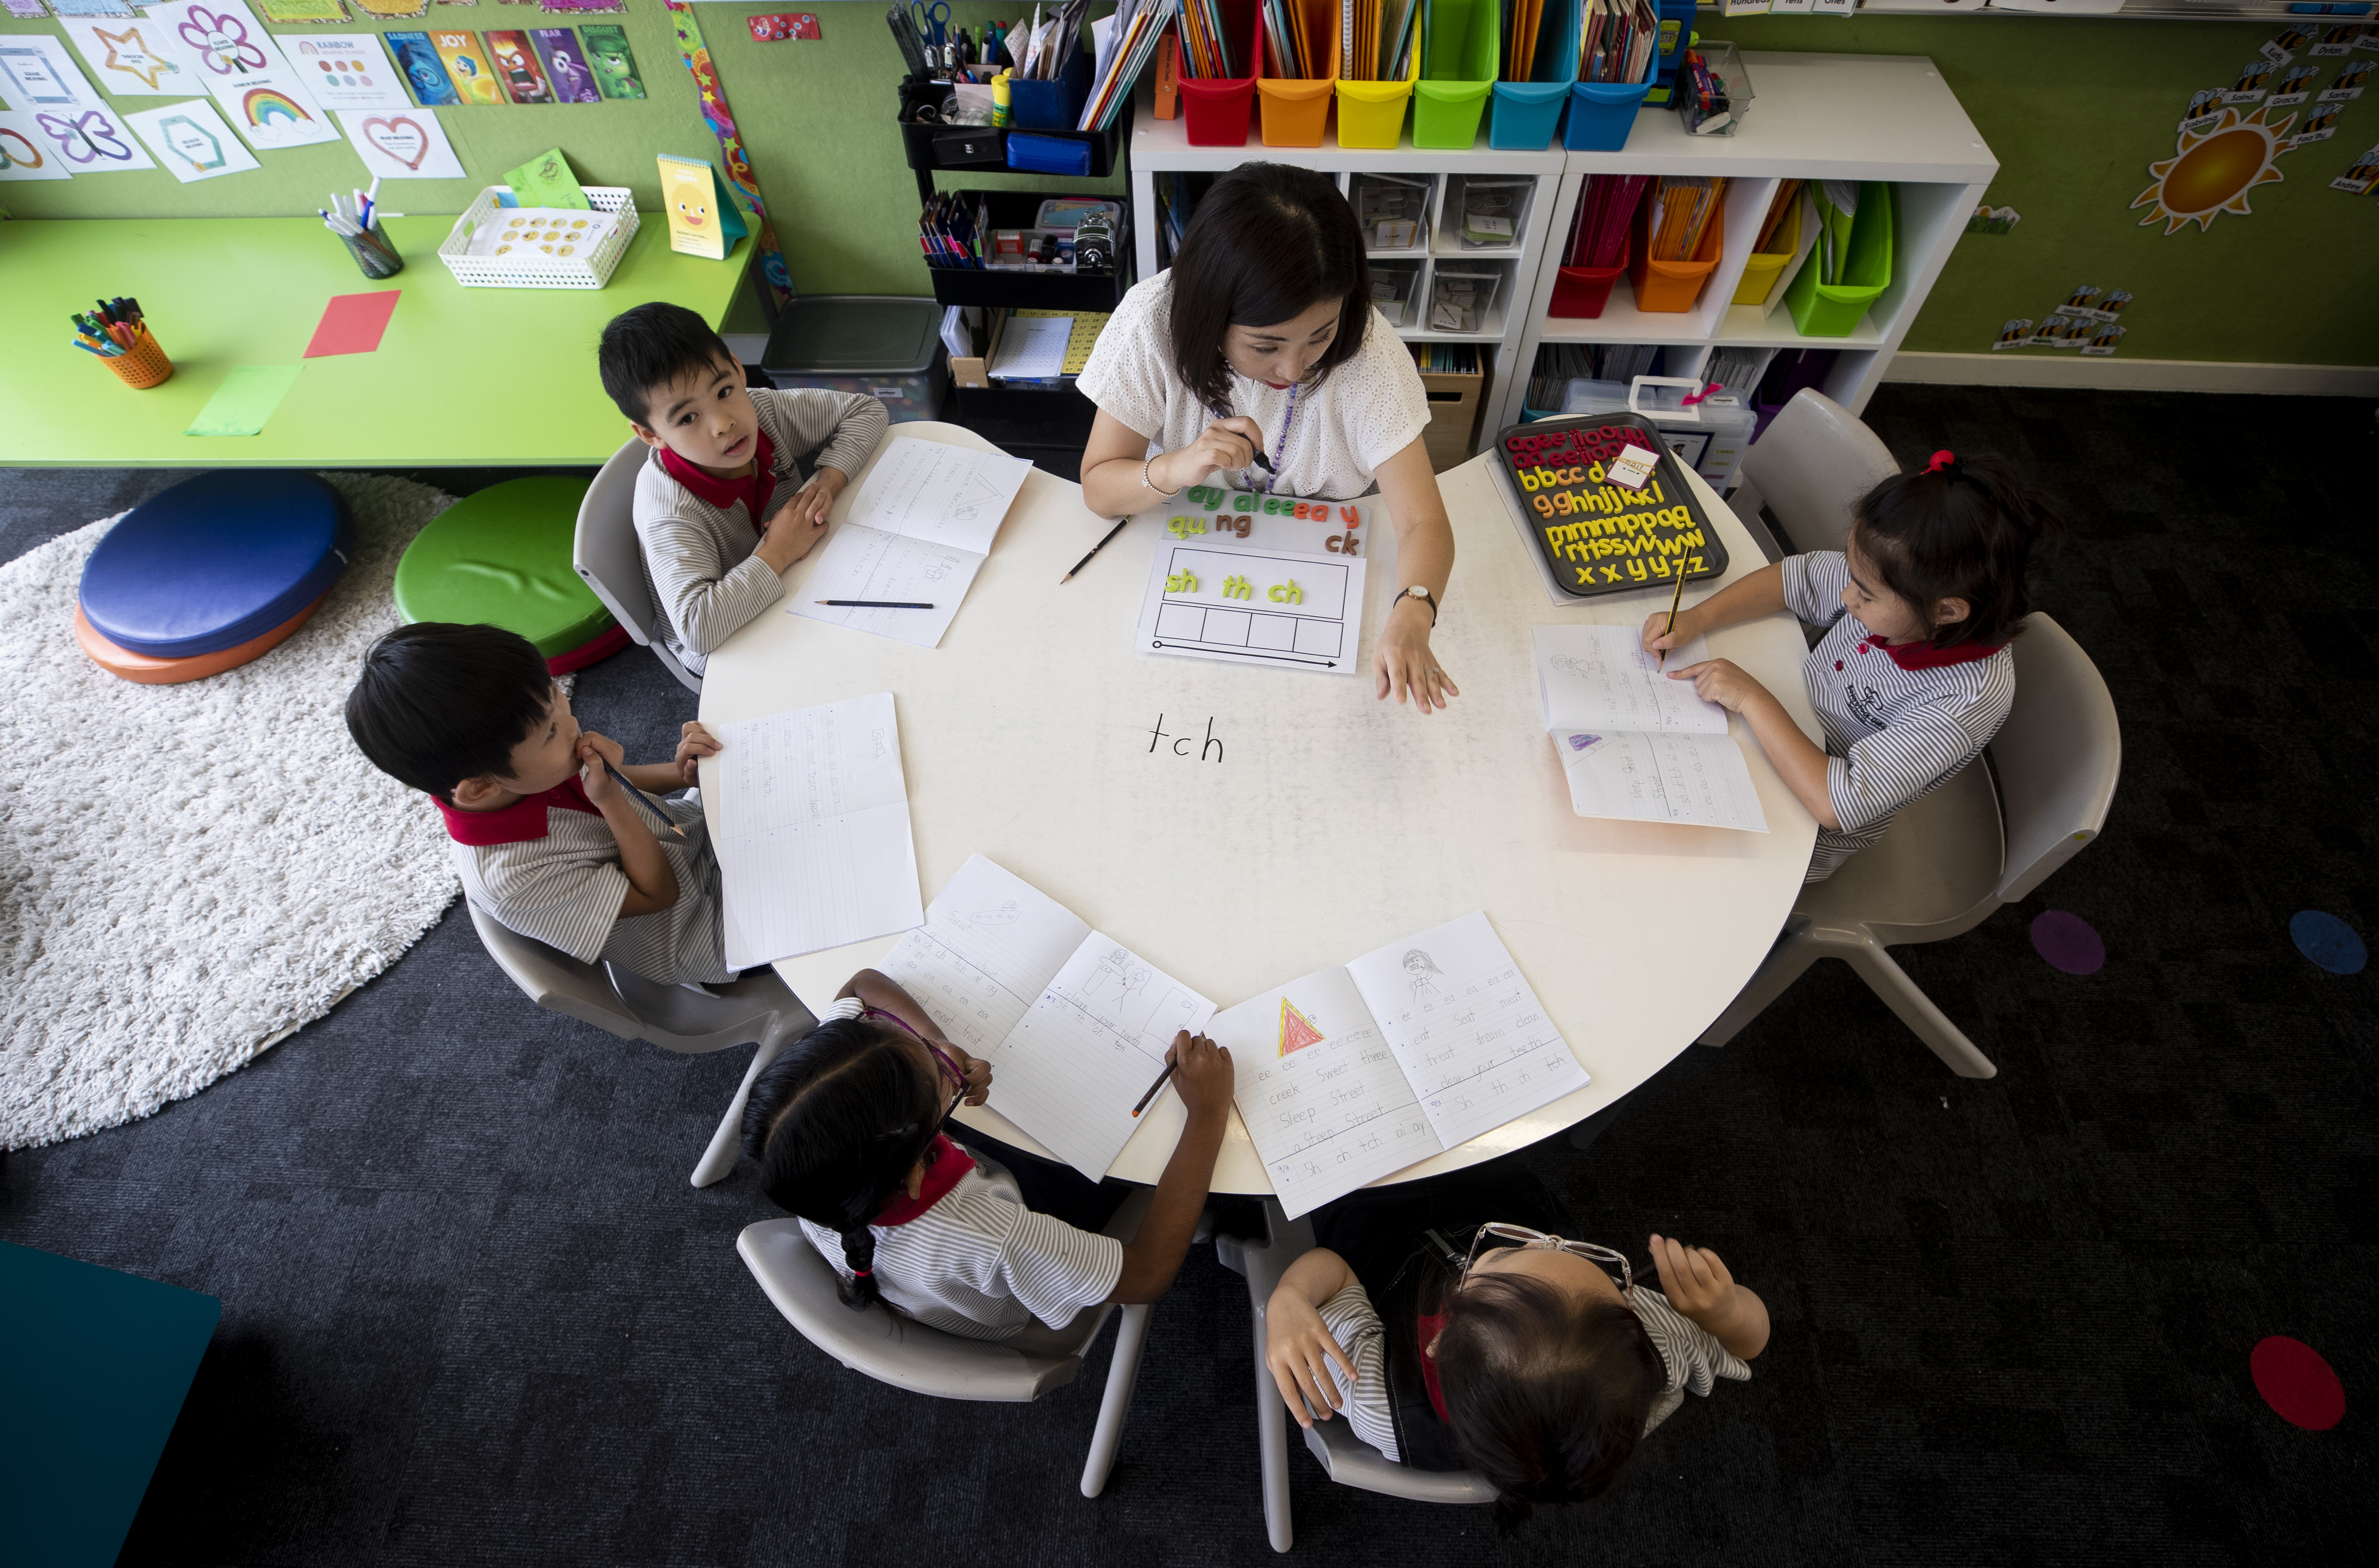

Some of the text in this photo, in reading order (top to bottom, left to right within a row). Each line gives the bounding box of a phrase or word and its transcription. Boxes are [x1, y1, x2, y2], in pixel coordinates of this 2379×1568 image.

[440, 35, 467, 48] JOY
[540, 29, 563, 38] FEAR
[582, 25, 618, 34] DISGUST
[2267, 48, 2283, 62] Kurtis
[2318, 47, 2343, 55] Dylan
[2360, 39, 2379, 49] Dariu
[2230, 93, 2254, 102] Saina
[2273, 96, 2299, 104] Grace
[2327, 91, 2351, 101] Sartaj
[2183, 116, 2218, 129] Sabrina
[2334, 180, 2361, 190] Andrew
[1167, 514, 1252, 540] qu ng
[1325, 530, 1360, 557] ck
[1165, 568, 1302, 605] sh th ch
[1148, 712, 1223, 764] tch
[935, 949, 947, 960] ch
[986, 985, 998, 998] ay
[1423, 969, 1516, 1012] ea ea ea ea ea
[1065, 991, 1088, 1012] clean
[1093, 1014, 1117, 1028] your
[1414, 1026, 1430, 1045] eat
[1500, 987, 1522, 1008] meat
[934, 1009, 985, 1045] meat treat
[1092, 1025, 1106, 1037] ch
[1425, 1012, 1540, 1066] treat dream clean
[1258, 1028, 1373, 1081] ee ee ee ee ee ee
[1270, 1082, 1300, 1105] creek
[1360, 1049, 1388, 1065] three
[1440, 1059, 1495, 1088] clean your
[1492, 1079, 1509, 1095] th
[1518, 1068, 1531, 1084] ch
[1294, 1144, 1301, 1153] a
[1336, 1147, 1352, 1164] ch
[1358, 1132, 1383, 1152] tch
[1396, 1123, 1407, 1138] ai
[1412, 1121, 1426, 1136] ay
[1277, 1165, 1290, 1173] 9/3
